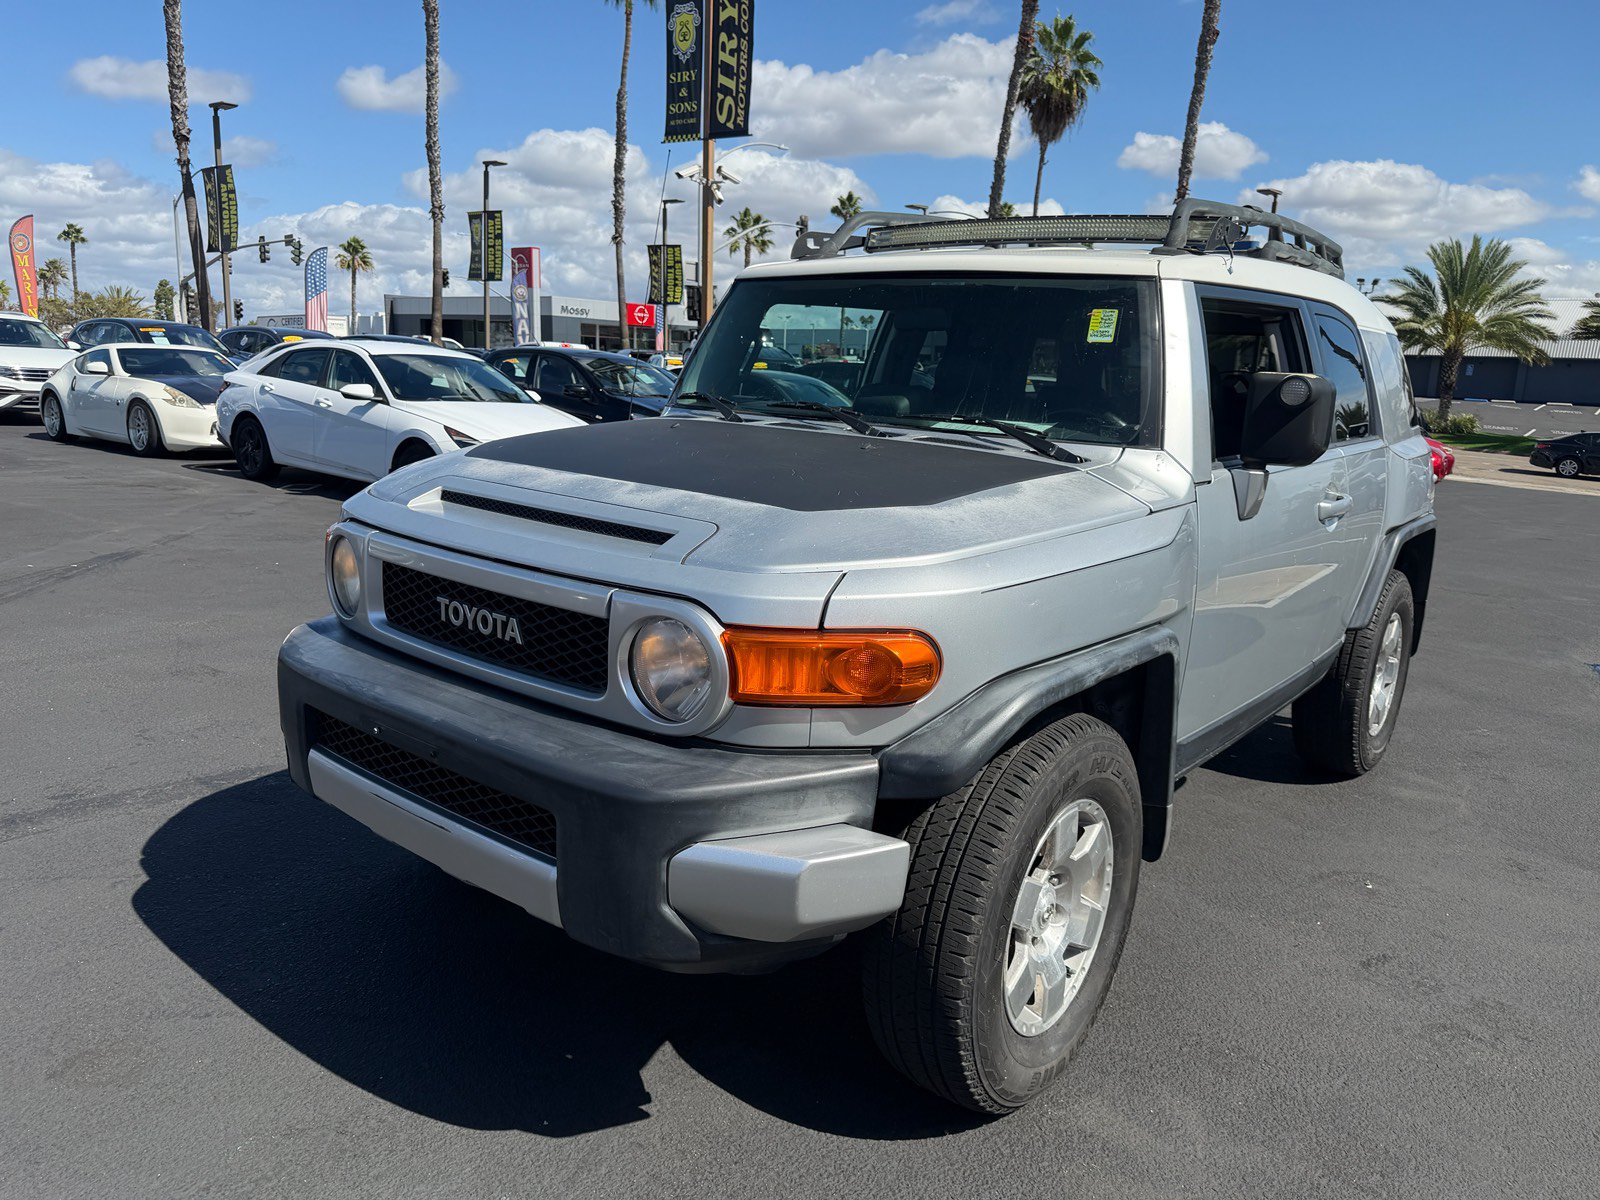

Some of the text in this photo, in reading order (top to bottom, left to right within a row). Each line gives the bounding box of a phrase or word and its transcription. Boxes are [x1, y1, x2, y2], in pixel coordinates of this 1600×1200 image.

[669, 69, 698, 84] SIRY
[716, 0, 739, 129] SIRY
[737, 0, 750, 128] MOTORS.CO
[669, 100, 698, 115] SONS
[678, 87, 689, 97] &
[220, 183, 231, 236] ANYONE
[225, 168, 239, 250] WE FINANCE
[487, 247, 495, 273] CARE
[494, 213, 502, 280] FULL SERVICE
[667, 267, 675, 303] TROOPS
[674, 247, 683, 304] WE SUPPORT
[281, 316, 304, 327] CERTIFIED
[560, 305, 591, 318] Mossy
[436, 596, 523, 646] TOYOTA
